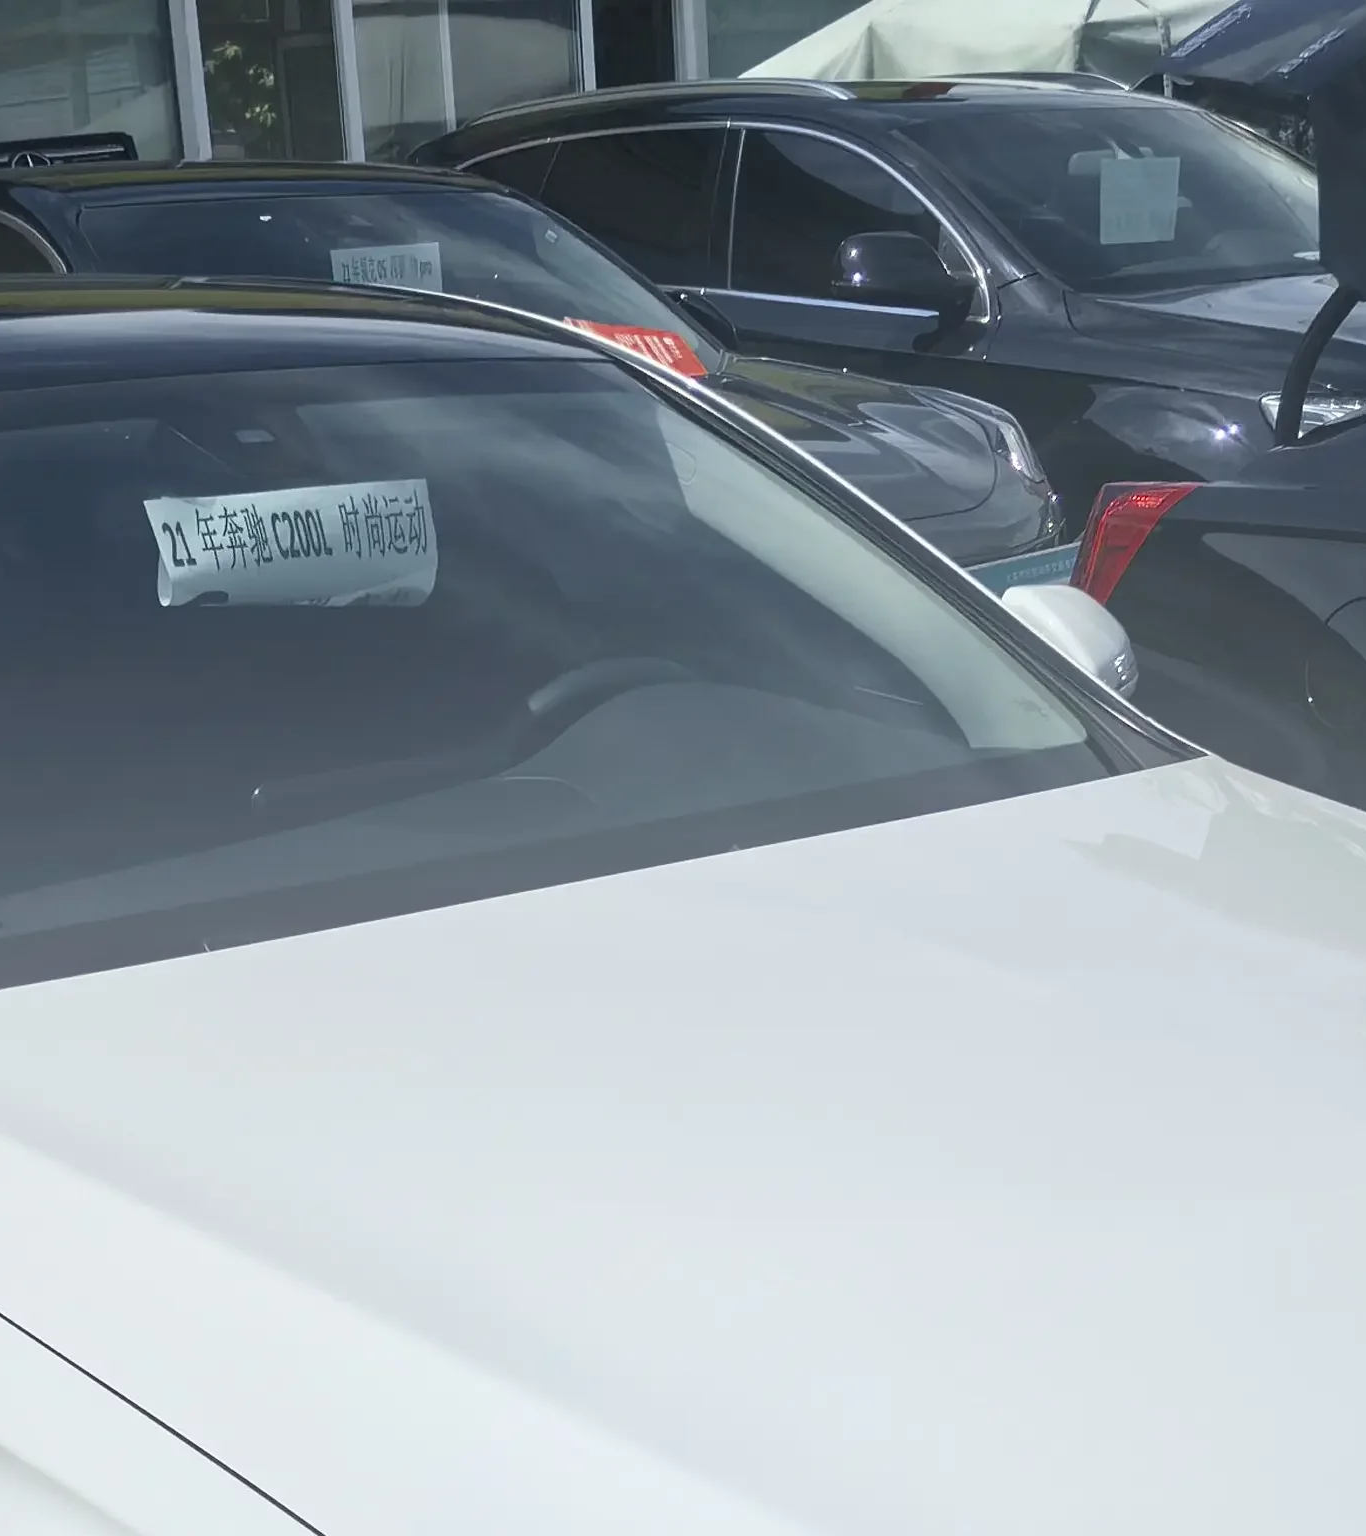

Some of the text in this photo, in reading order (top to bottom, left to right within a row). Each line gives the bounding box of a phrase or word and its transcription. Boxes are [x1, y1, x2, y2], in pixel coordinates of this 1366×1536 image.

[162, 521, 197, 567] 21
[338, 489, 428, 560] 时尚运动
